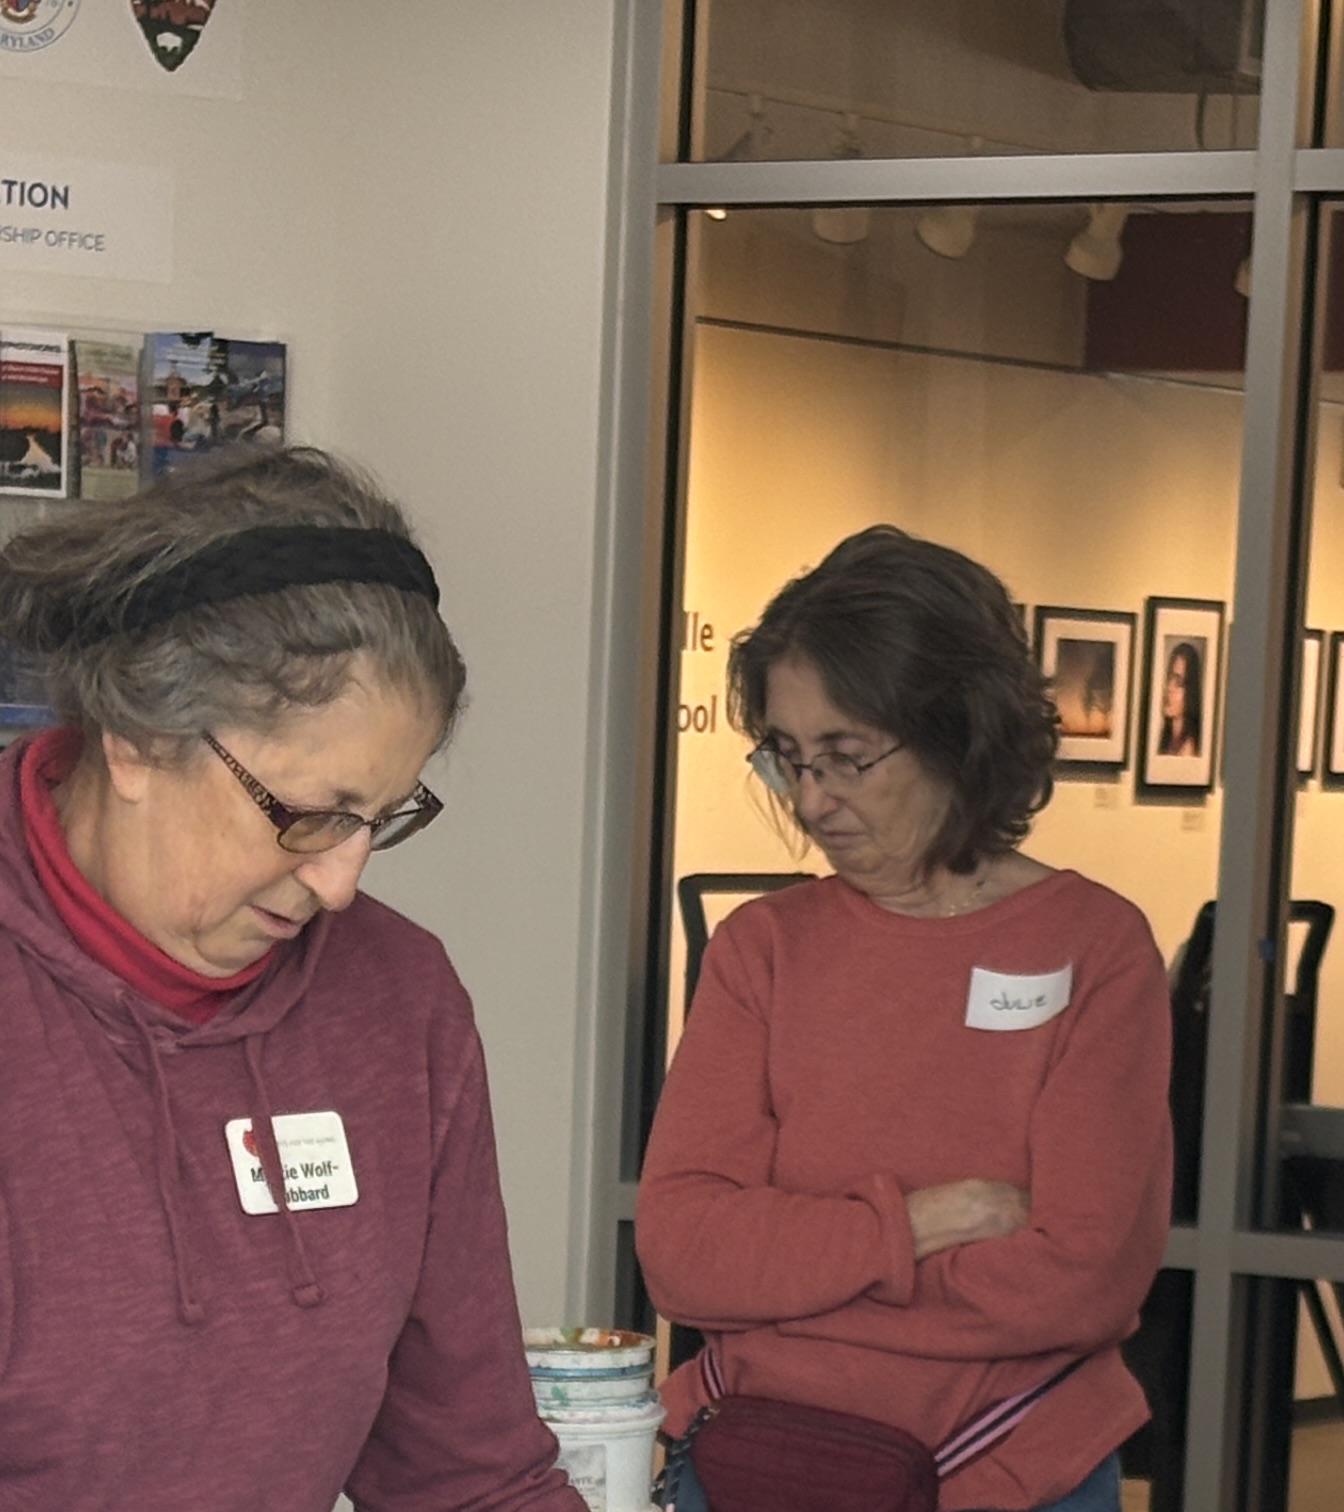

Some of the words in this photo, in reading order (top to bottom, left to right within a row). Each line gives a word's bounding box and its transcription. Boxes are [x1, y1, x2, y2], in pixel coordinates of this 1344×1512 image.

[45, 230, 105, 251] OFFICE
[678, 694, 717, 733] ool
[300, 1161, 339, 1179] Wolf-
